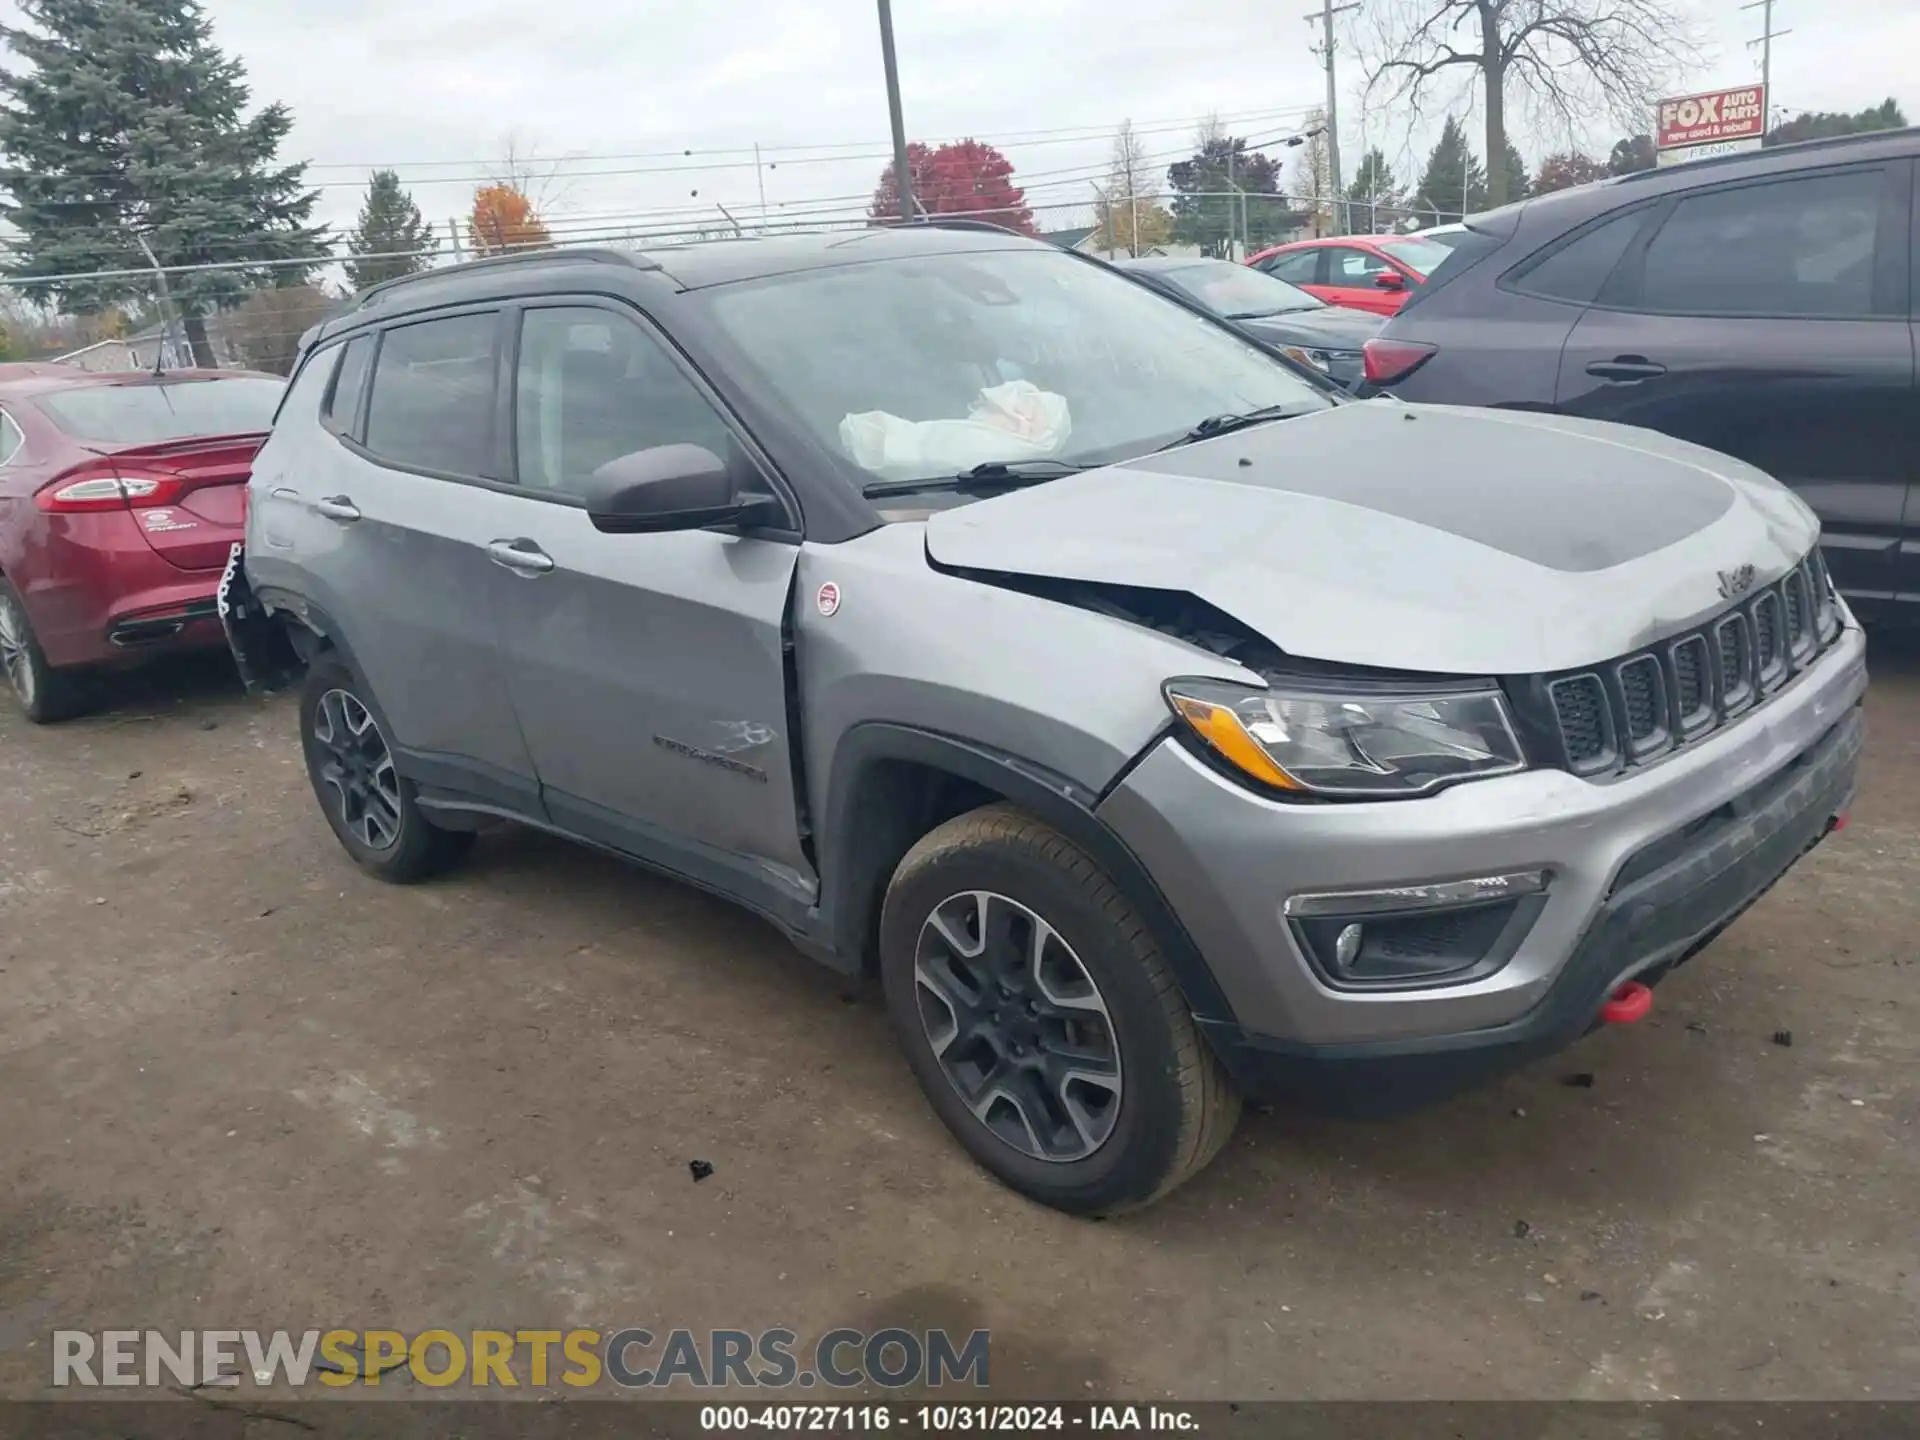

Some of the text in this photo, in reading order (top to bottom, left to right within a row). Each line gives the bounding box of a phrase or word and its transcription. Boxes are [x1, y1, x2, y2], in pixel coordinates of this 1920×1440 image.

[1722, 91, 1756, 108] AUTO
[1661, 96, 1720, 130] FOX
[1722, 104, 1760, 121] PARTS
